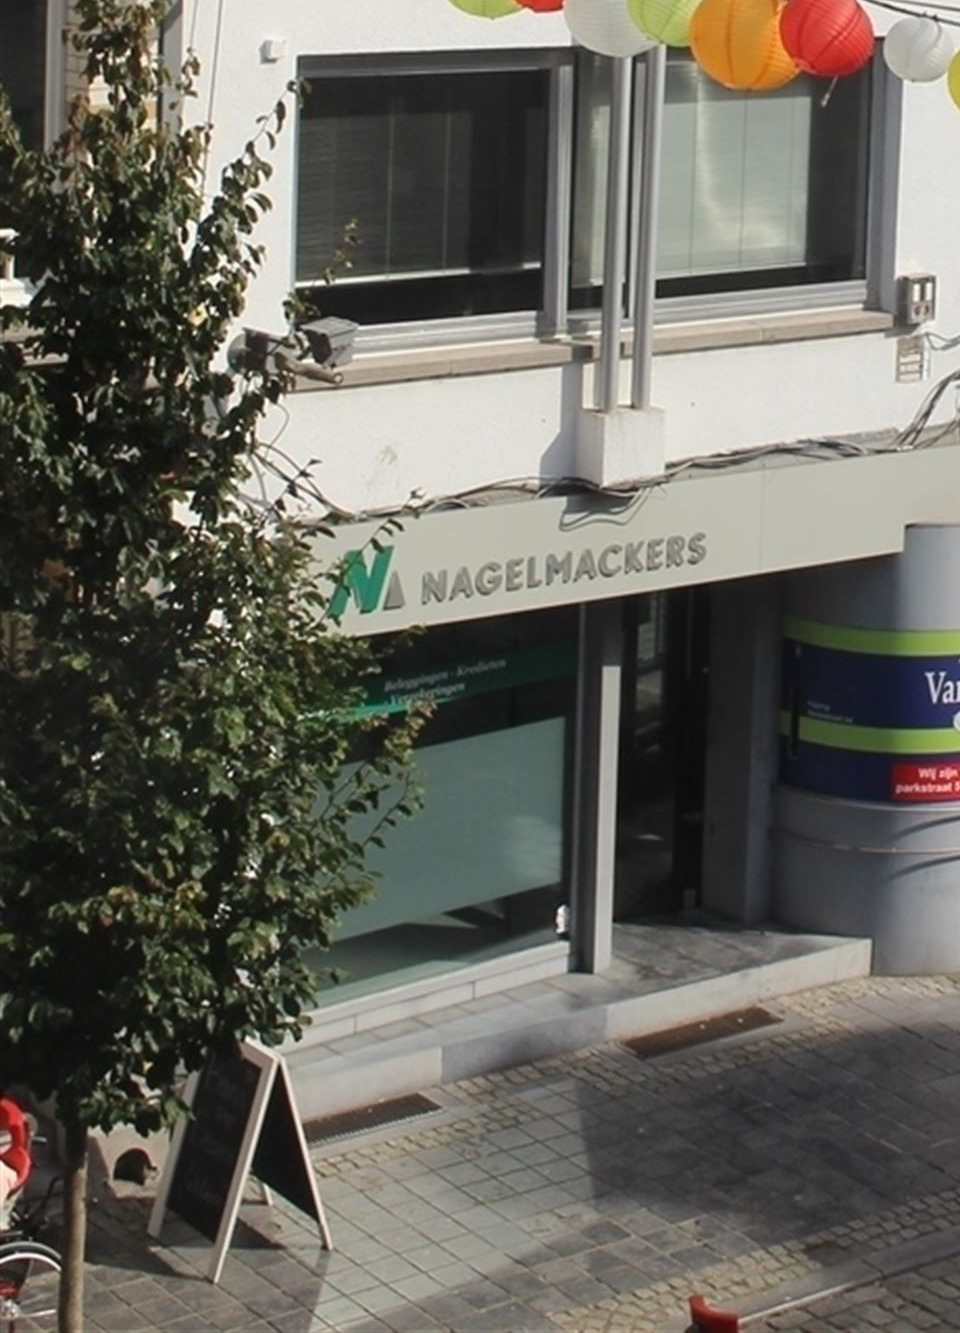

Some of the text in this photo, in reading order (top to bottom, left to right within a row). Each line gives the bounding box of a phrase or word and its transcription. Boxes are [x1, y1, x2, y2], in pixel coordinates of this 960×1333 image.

[421, 531, 707, 606] NAGELMACKERS
[918, 767, 937, 780] Wij
[939, 766, 958, 779] zijn
